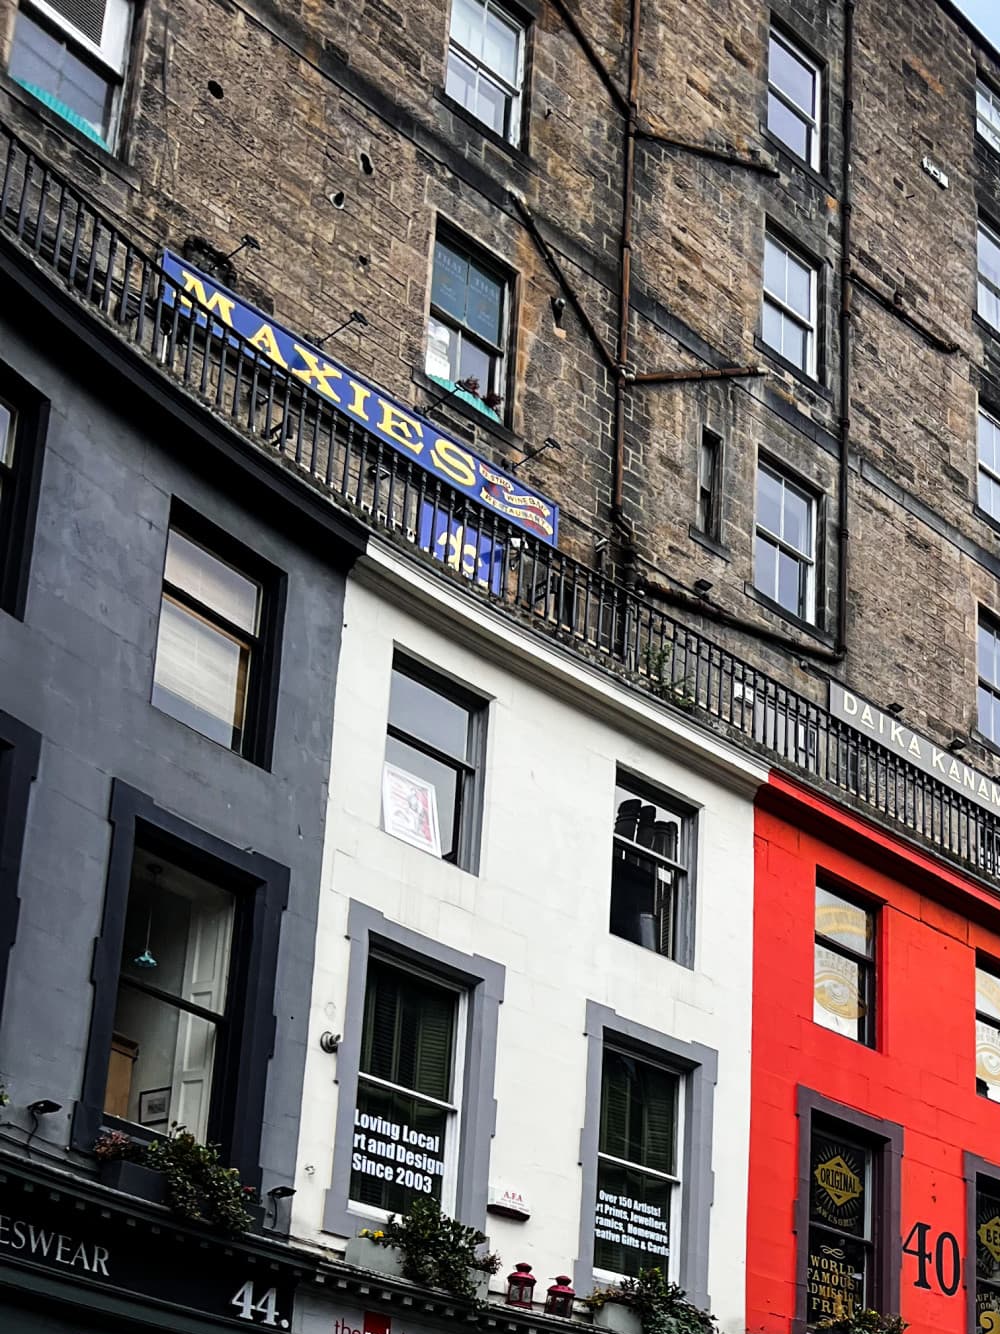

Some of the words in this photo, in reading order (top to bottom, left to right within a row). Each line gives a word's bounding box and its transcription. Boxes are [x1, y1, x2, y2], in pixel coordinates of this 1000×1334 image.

[173, 271, 476, 486] MAXIES
[842, 690, 922, 759] DAIKA
[353, 1108, 401, 1141] Loving
[402, 1124, 440, 1153] Local
[352, 1152, 394, 1182] Since
[395, 1166, 432, 1194] 2003
[367, 1138, 396, 1160] and
[396, 1144, 445, 1176] Design
[820, 1167, 857, 1194] ORIGINAL
[599, 1189, 618, 1205] Over
[618, 1195, 633, 1209] 150
[633, 1199, 661, 1217] Artists!
[604, 1203, 629, 1221] Prints,
[630, 1211, 668, 1233] Jewellery,
[621, 1234, 640, 1249] Gifts
[640, 1241, 647, 1251] &
[647, 1241, 670, 1257] Cards
[627, 1223, 668, 1244] Homeware
[810, 1254, 855, 1276] WORLD
[902, 1221, 961, 1297] 40
